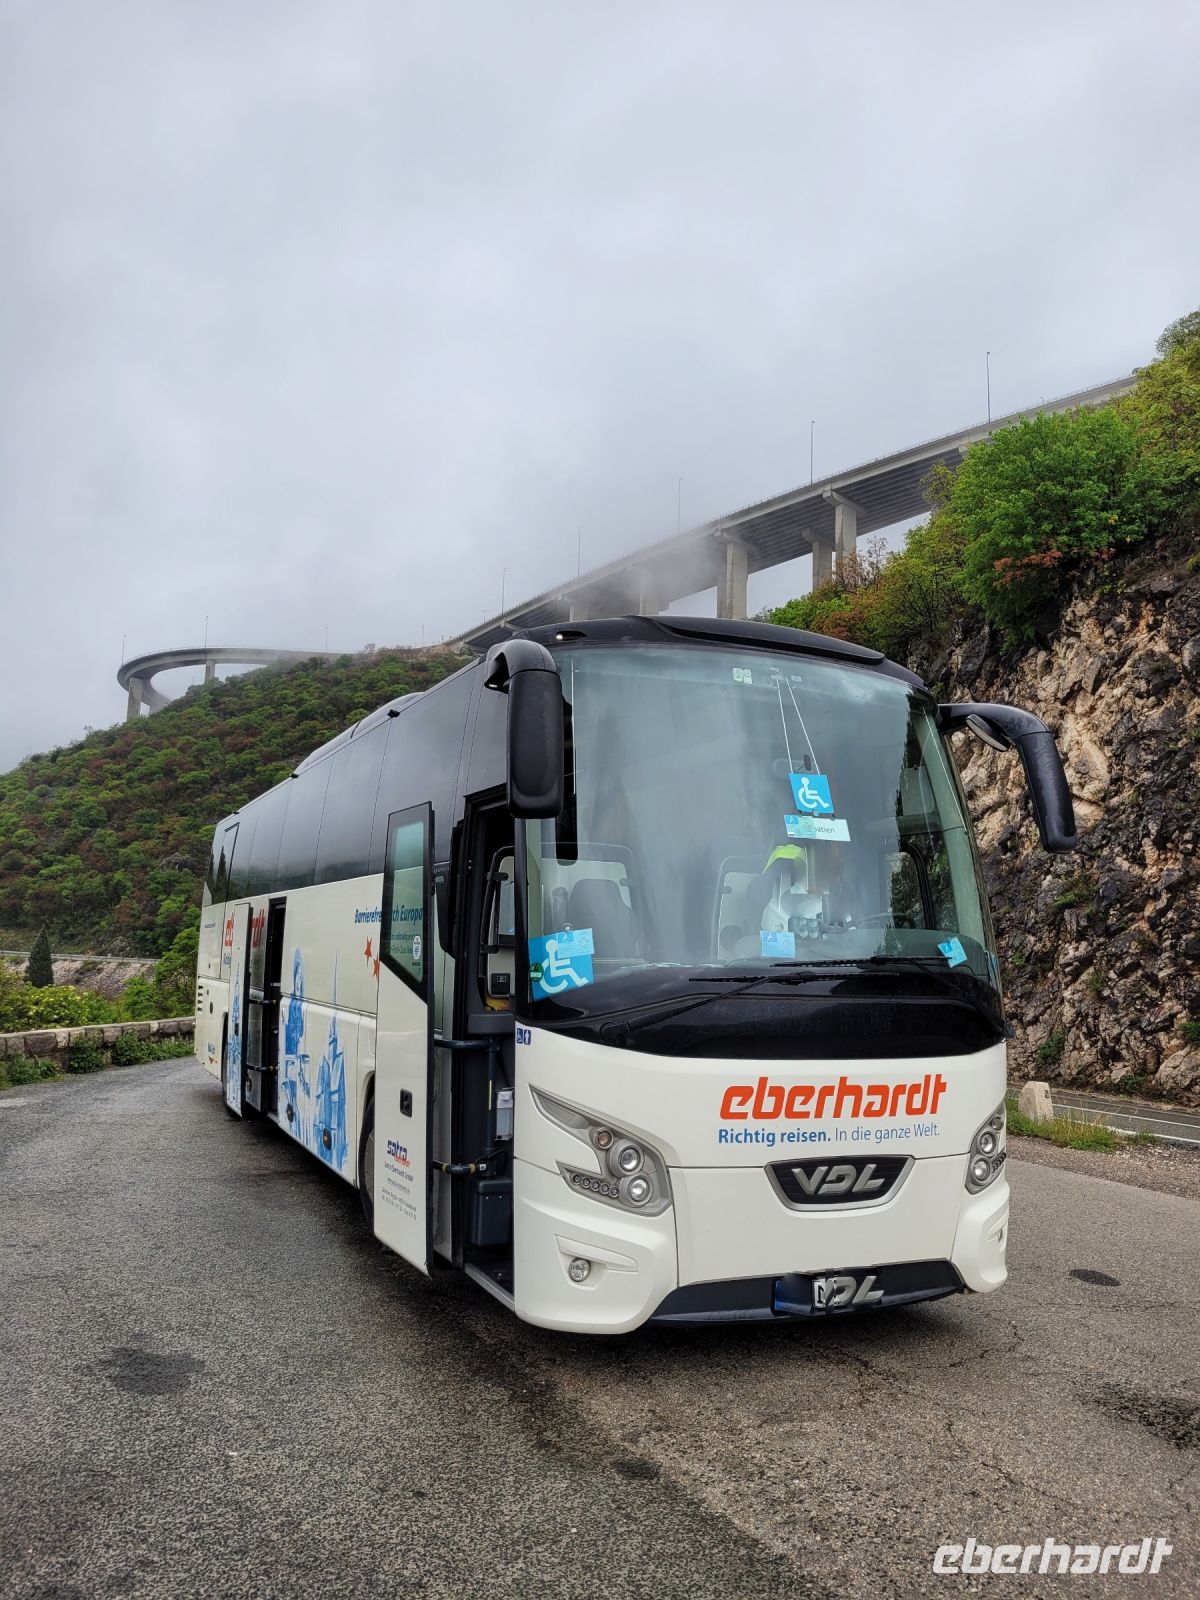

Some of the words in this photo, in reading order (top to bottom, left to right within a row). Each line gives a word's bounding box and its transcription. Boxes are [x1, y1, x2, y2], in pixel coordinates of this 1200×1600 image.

[354, 906, 382, 924] Barrierefre
[719, 1073, 947, 1120] eberhardt
[718, 1128, 776, 1148] Richtig
[780, 1128, 831, 1144] reisen.
[835, 1127, 847, 1142] In
[851, 1126, 871, 1141] die
[875, 1125, 911, 1144] ganze
[913, 1121, 940, 1138] Welt.
[791, 1163, 885, 1196] VDL
